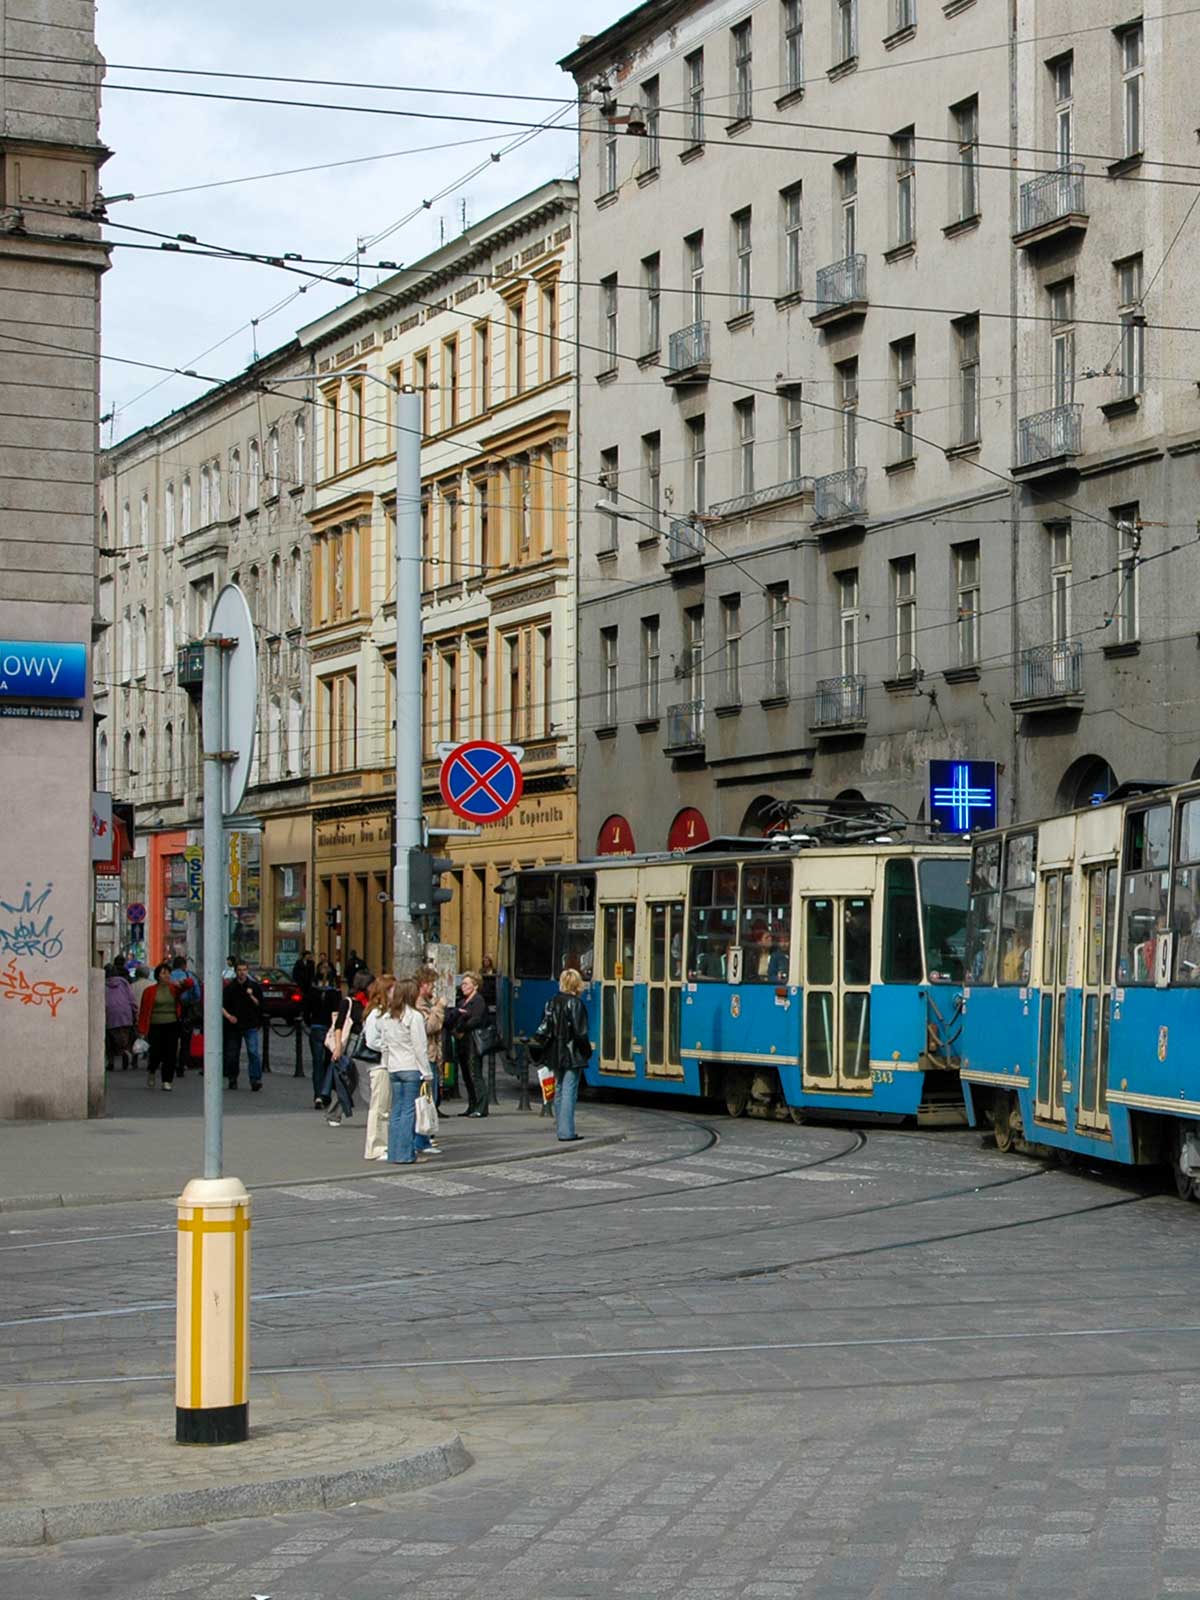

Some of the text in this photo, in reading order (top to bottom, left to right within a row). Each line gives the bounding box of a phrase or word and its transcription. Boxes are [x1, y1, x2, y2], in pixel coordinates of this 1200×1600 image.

[191, 858, 202, 900] SEX
[733, 953, 738, 978] 9
[1162, 938, 1168, 978] 9
